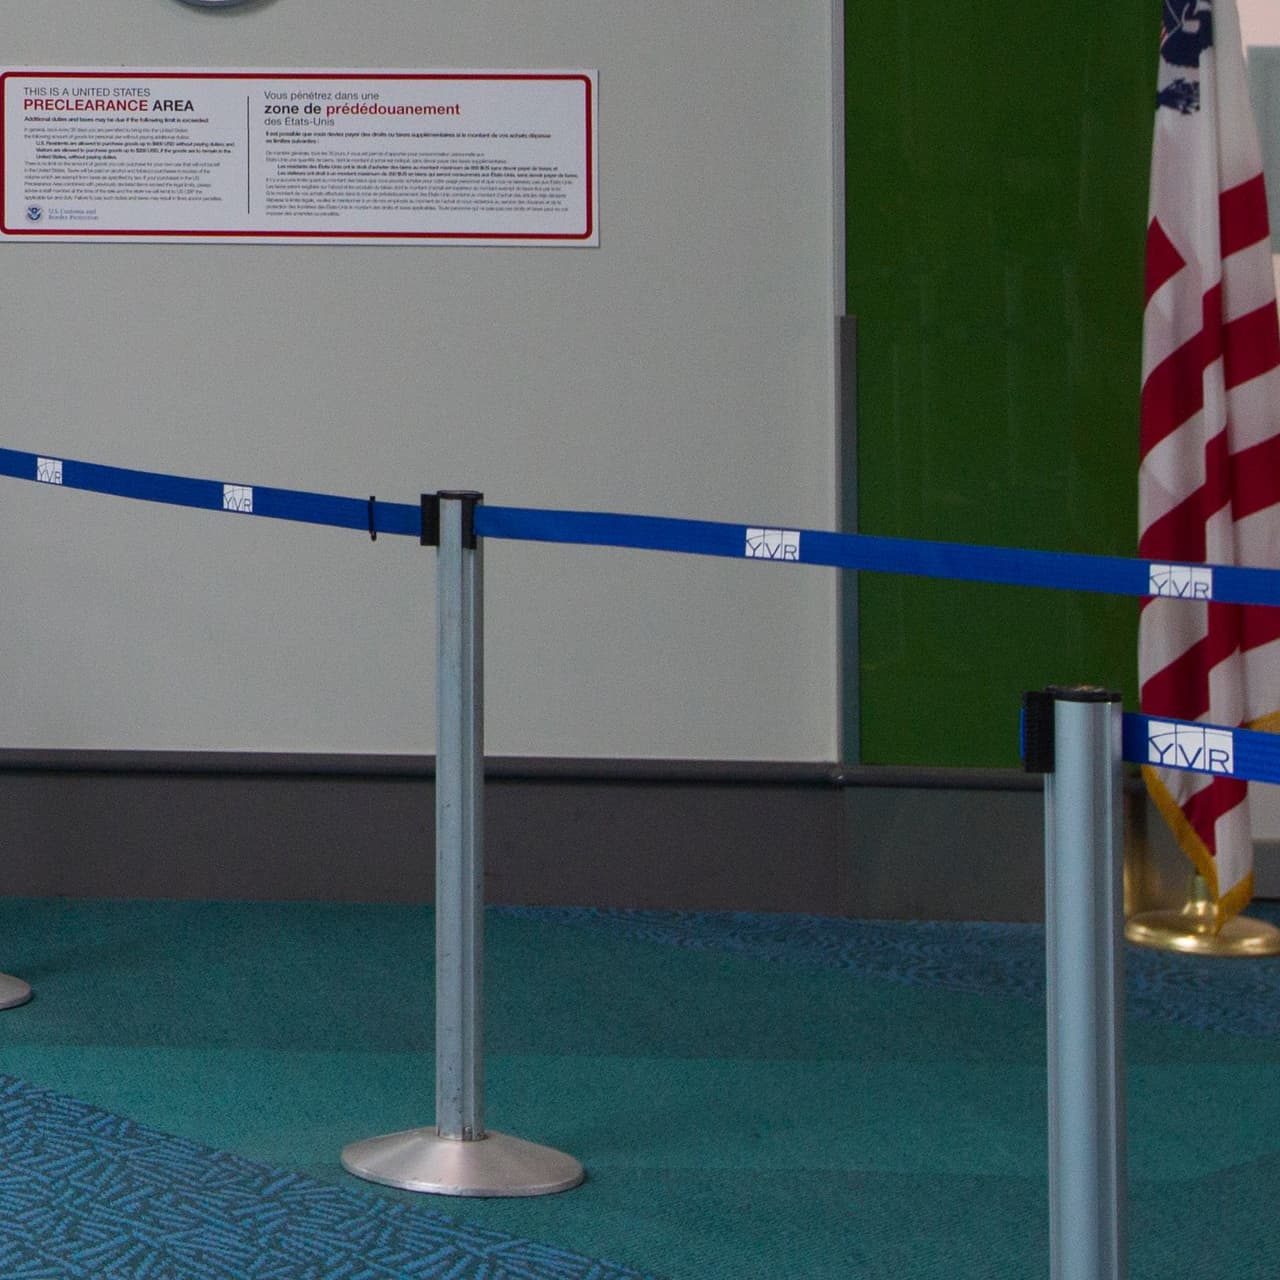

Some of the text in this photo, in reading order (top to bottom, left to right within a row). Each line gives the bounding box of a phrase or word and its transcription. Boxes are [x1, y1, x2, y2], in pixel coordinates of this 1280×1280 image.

[24, 87, 151, 97] THIS IS A UNITED STATES
[264, 90, 380, 102] Vous pénétrez dans une
[24, 99, 195, 112] PRECLEARANCE AREA
[264, 103, 460, 117] zone de prédédouanement
[264, 117, 282, 126] des
[37, 465, 62, 484] YVR
[223, 494, 252, 512] YVR
[746, 540, 798, 560] YVR
[1150, 576, 1210, 599] YVR
[1149, 738, 1231, 773] YVR
